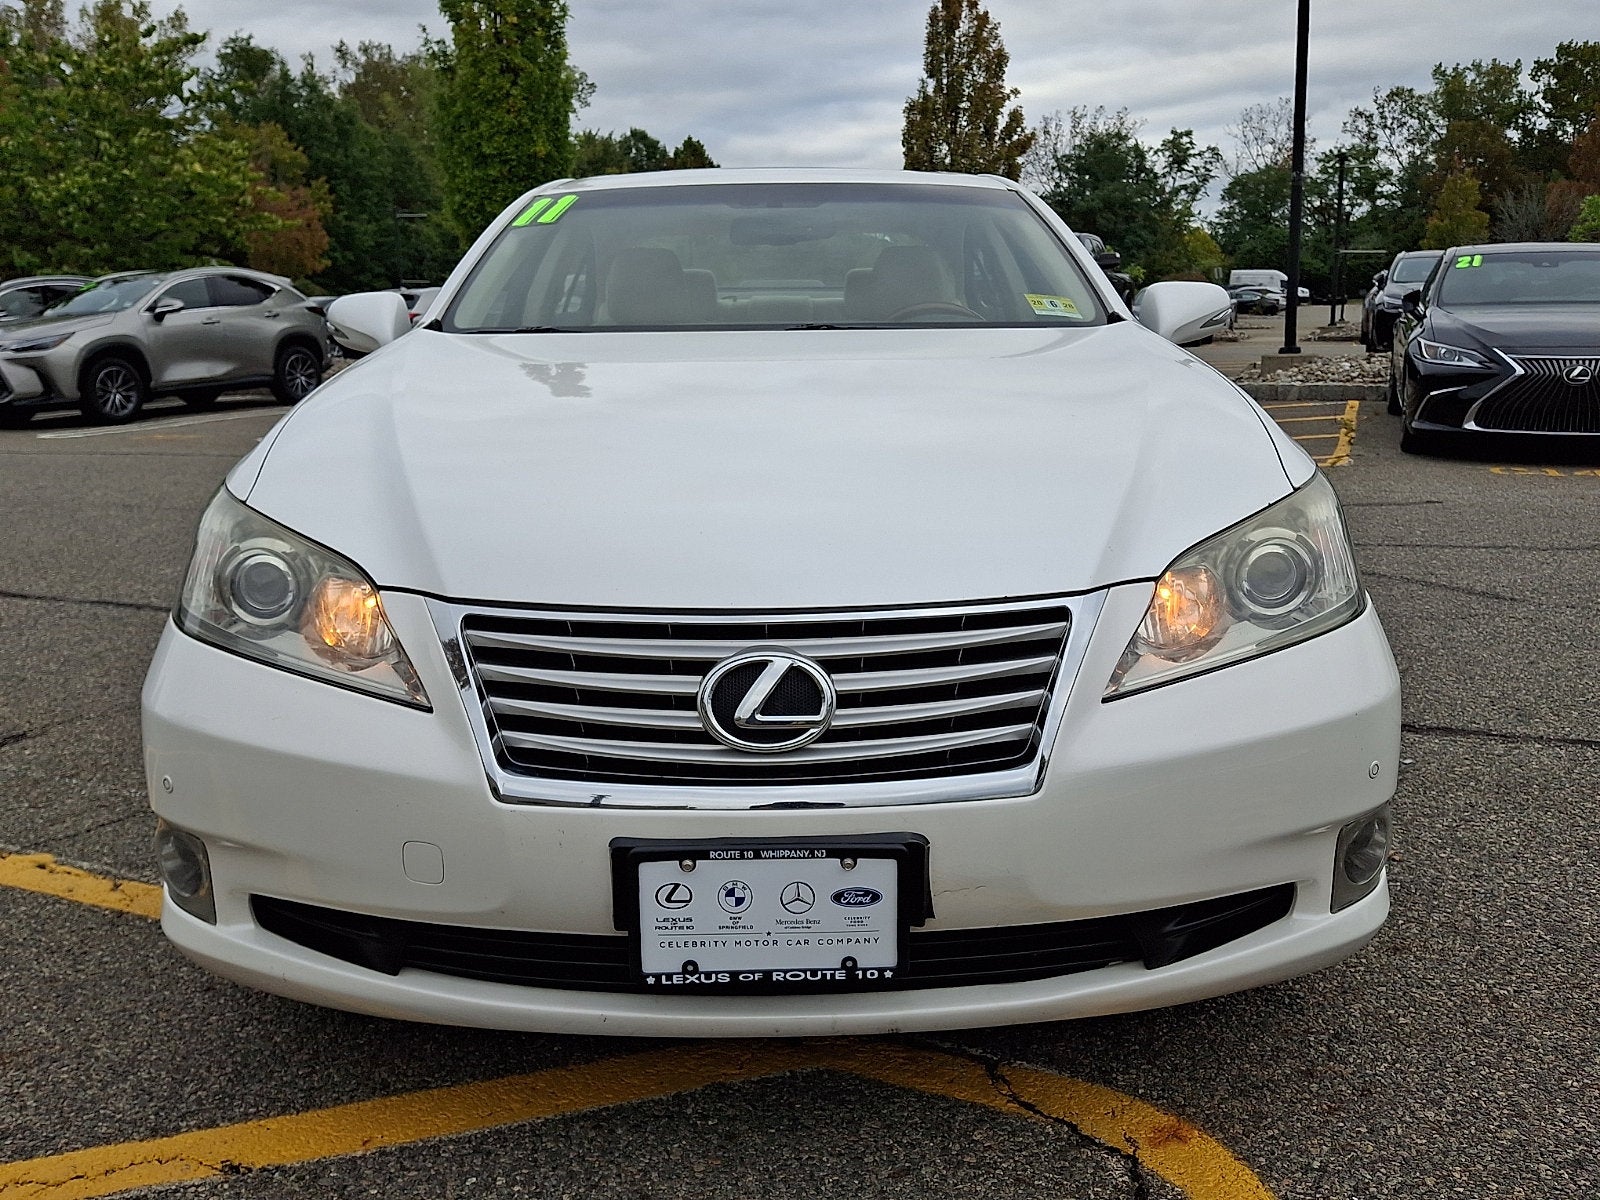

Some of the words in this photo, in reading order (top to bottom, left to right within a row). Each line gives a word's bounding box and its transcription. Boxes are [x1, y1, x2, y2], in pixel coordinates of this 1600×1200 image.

[511, 194, 579, 227] 11
[1455, 254, 1483, 269] 21
[1049, 300, 1058, 308] 6
[709, 850, 741, 859] ROUTE
[743, 850, 754, 859] 10
[814, 849, 826, 858] NJ
[840, 890, 872, 904] Ford
[659, 940, 728, 949] CELEBRITY
[734, 939, 779, 948] MOTOR
[786, 938, 811, 947] CAR
[817, 936, 880, 946] COMPANY
[661, 972, 731, 985] LEXUS
[738, 972, 763, 982] OF
[772, 970, 847, 982] ROUTE
[855, 969, 879, 980] 10
